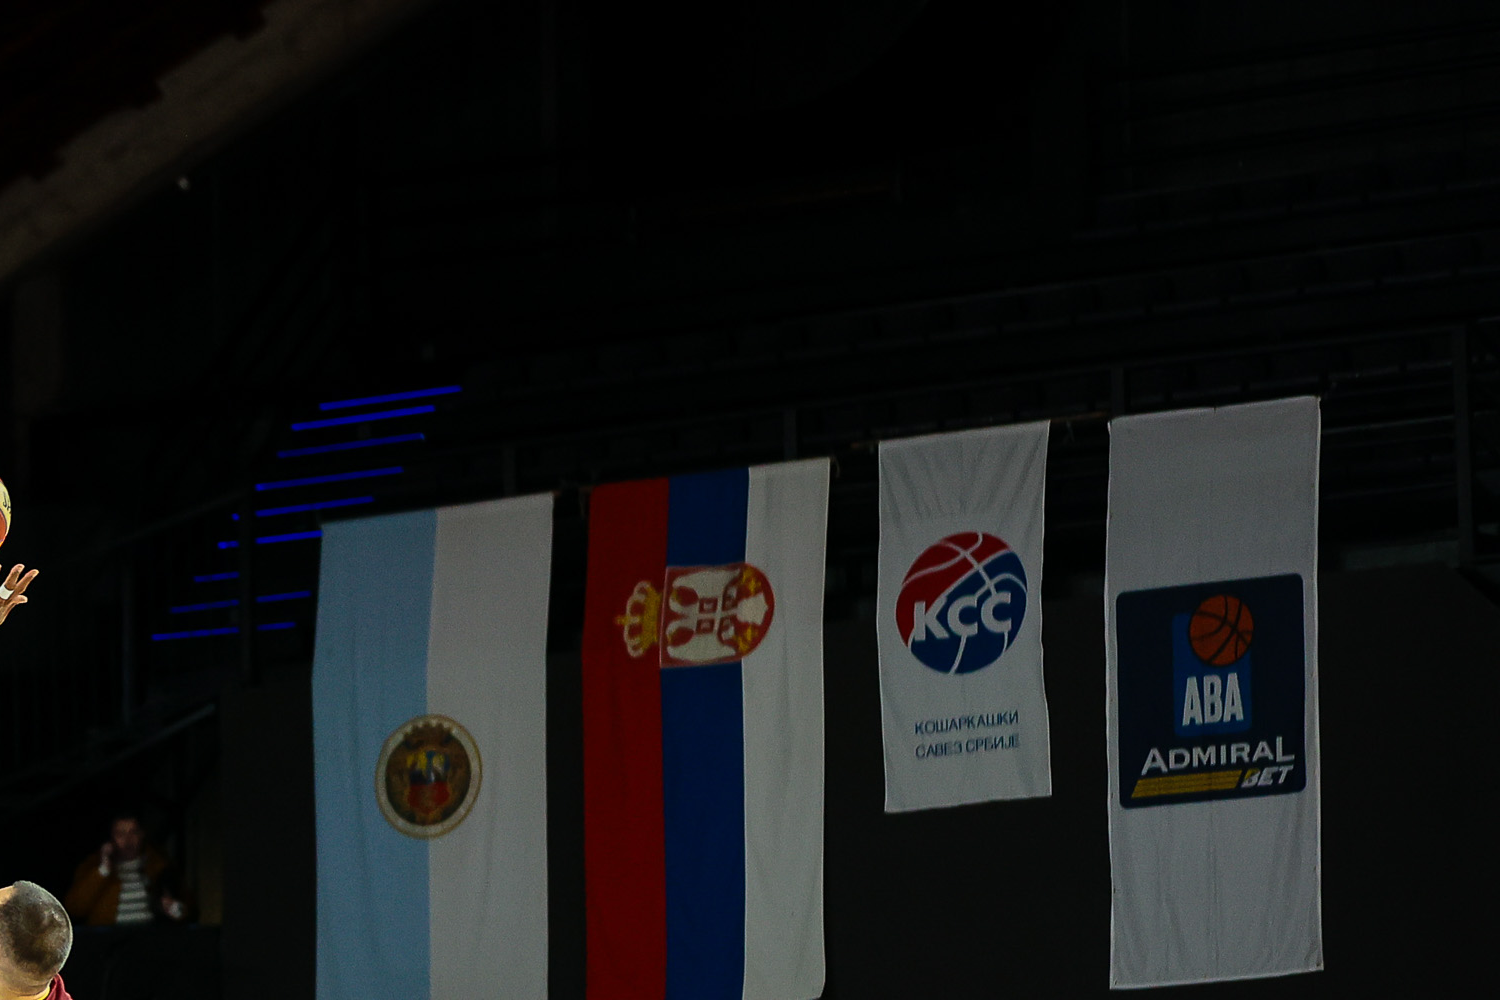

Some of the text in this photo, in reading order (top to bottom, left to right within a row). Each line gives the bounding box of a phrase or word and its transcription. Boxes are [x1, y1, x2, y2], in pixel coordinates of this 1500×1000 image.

[1182, 672, 1244, 726] ABA
[914, 709, 1019, 735] КОШАРКАШКИ
[915, 732, 1020, 759] САВЕЗ СРБИЈЕ
[1141, 736, 1295, 776] ADMIRAL
[1241, 765, 1294, 788] BET
